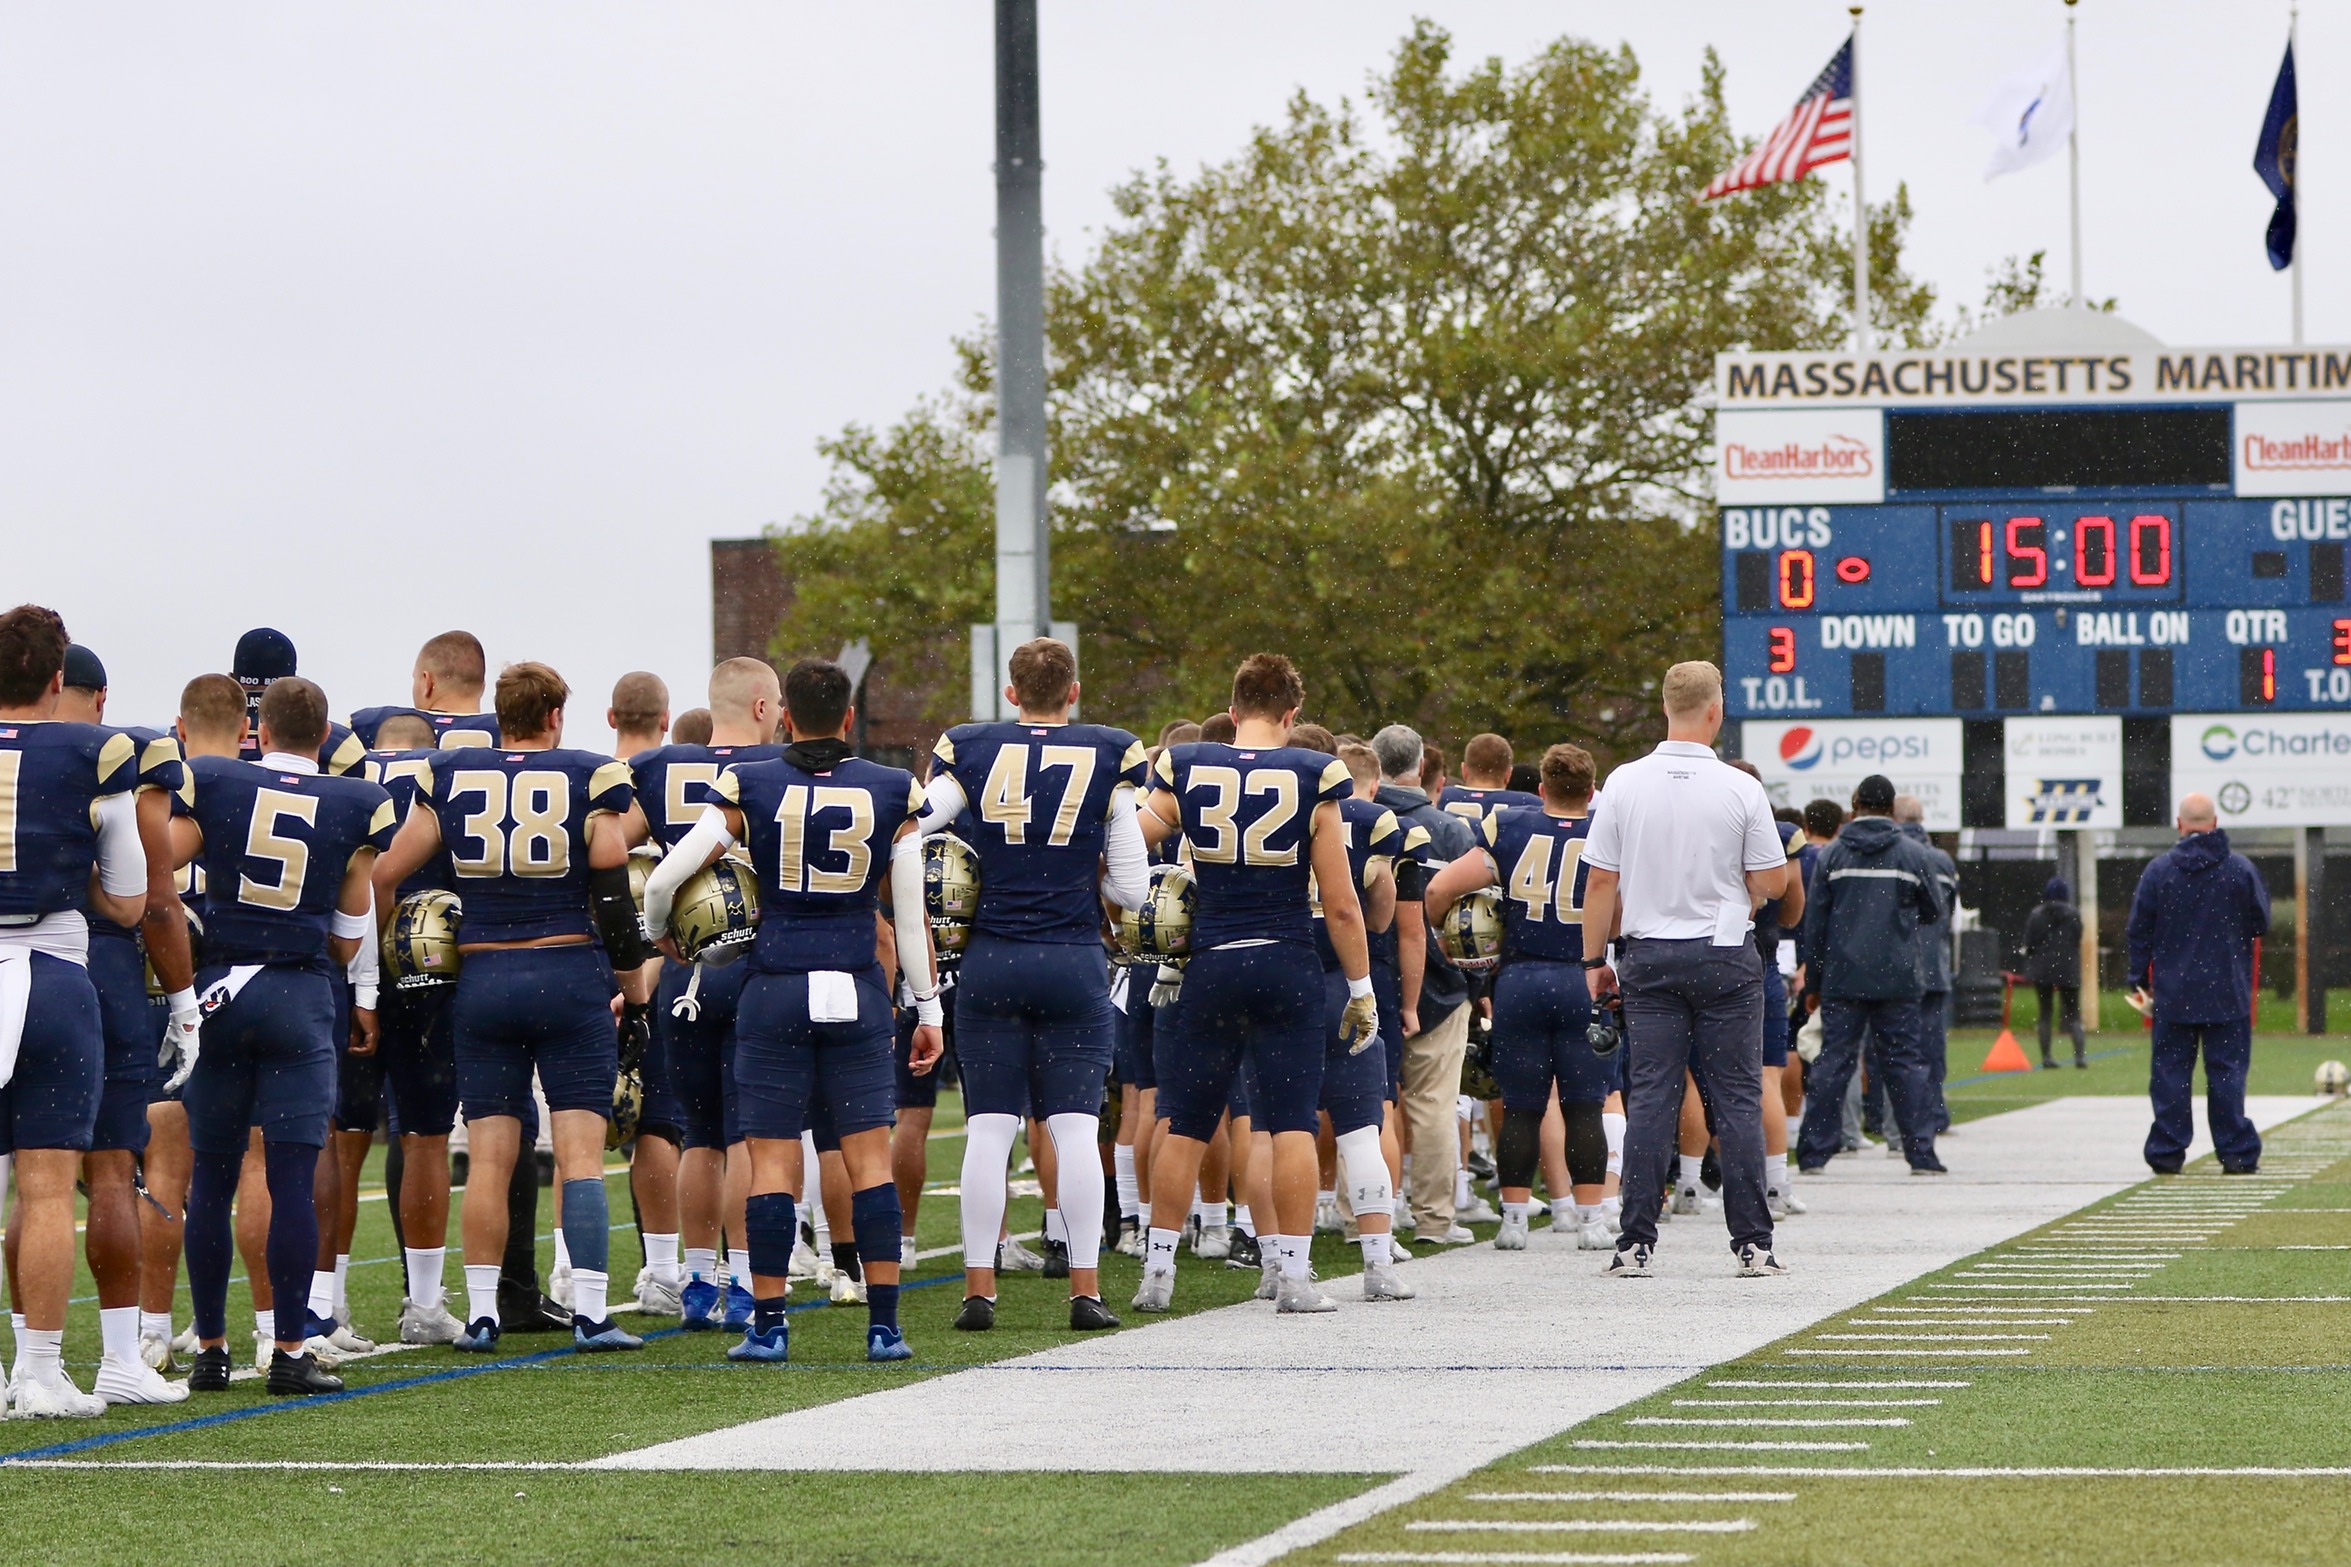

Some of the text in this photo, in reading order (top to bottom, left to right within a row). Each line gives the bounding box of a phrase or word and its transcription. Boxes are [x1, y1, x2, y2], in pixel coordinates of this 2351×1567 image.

[1727, 357, 2132, 398] MASSACHUSETTS
[1726, 434, 1873, 479] CleanHarbors
[1725, 507, 1832, 549] BUCS
[2271, 499, 2351, 540] GUE
[1979, 516, 2171, 587] 15:00
[1779, 550, 1814, 608] 0
[1820, 615, 1916, 648] DOWN
[1943, 613, 2036, 648] TO GO
[2076, 611, 2189, 646] BALL ON
[2225, 610, 2288, 645] QTR
[1768, 627, 1795, 673] 3
[240, 676, 259, 684] BOO
[1741, 676, 1823, 710] T.O.L.
[2262, 648, 2275, 700] 1
[1832, 736, 1929, 765] pepsi
[980, 743, 1097, 846] 47
[447, 769, 570, 879] 38
[1185, 765, 1299, 866] 32
[238, 786, 319, 911] 5
[774, 784, 875, 894] 13
[721, 927, 753, 940] schutt
[400, 973, 429, 983] schutt
